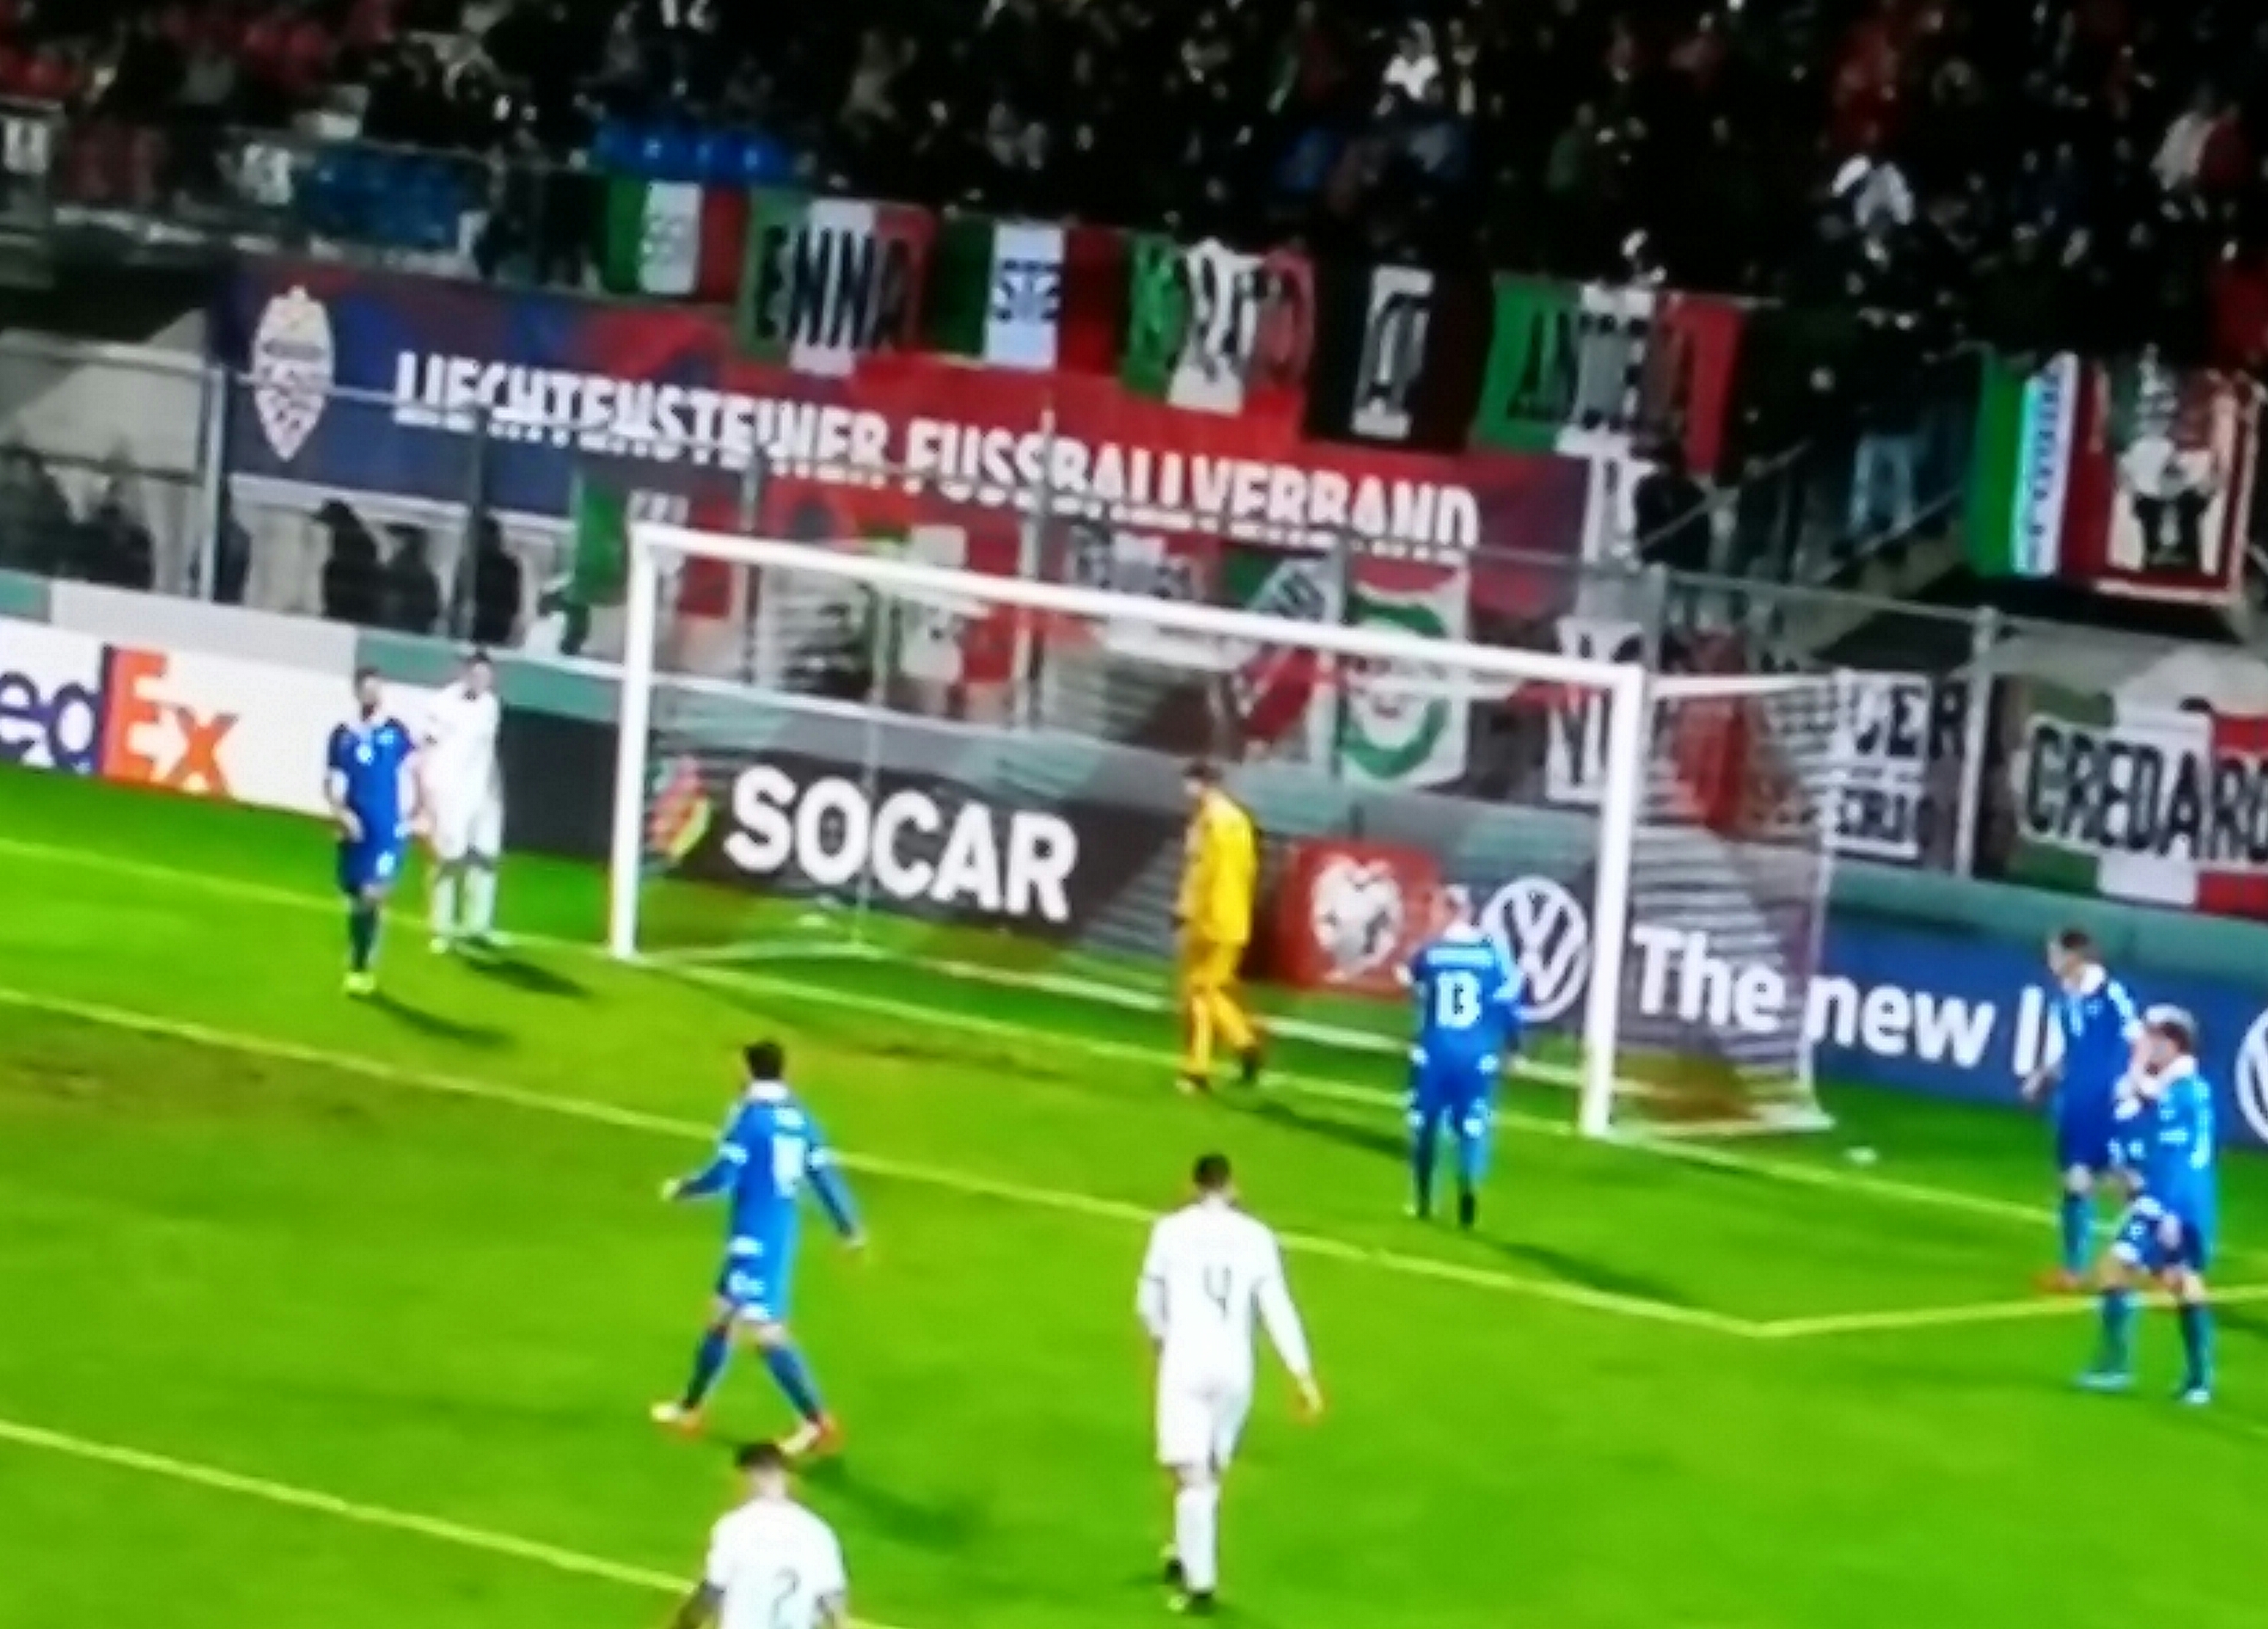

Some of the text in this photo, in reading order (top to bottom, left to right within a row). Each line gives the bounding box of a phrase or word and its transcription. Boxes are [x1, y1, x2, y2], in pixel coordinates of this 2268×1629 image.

[393, 351, 889, 490] LIECHTENSTEINER
[904, 419, 1482, 567] FUSSBALLVERBAND
[723, 764, 1078, 923] SOCAR
[1633, 926, 1788, 1032] The
[1806, 975, 1996, 1069] new
[1201, 1262, 1232, 1320] 4
[768, 1565, 803, 1629] 2
